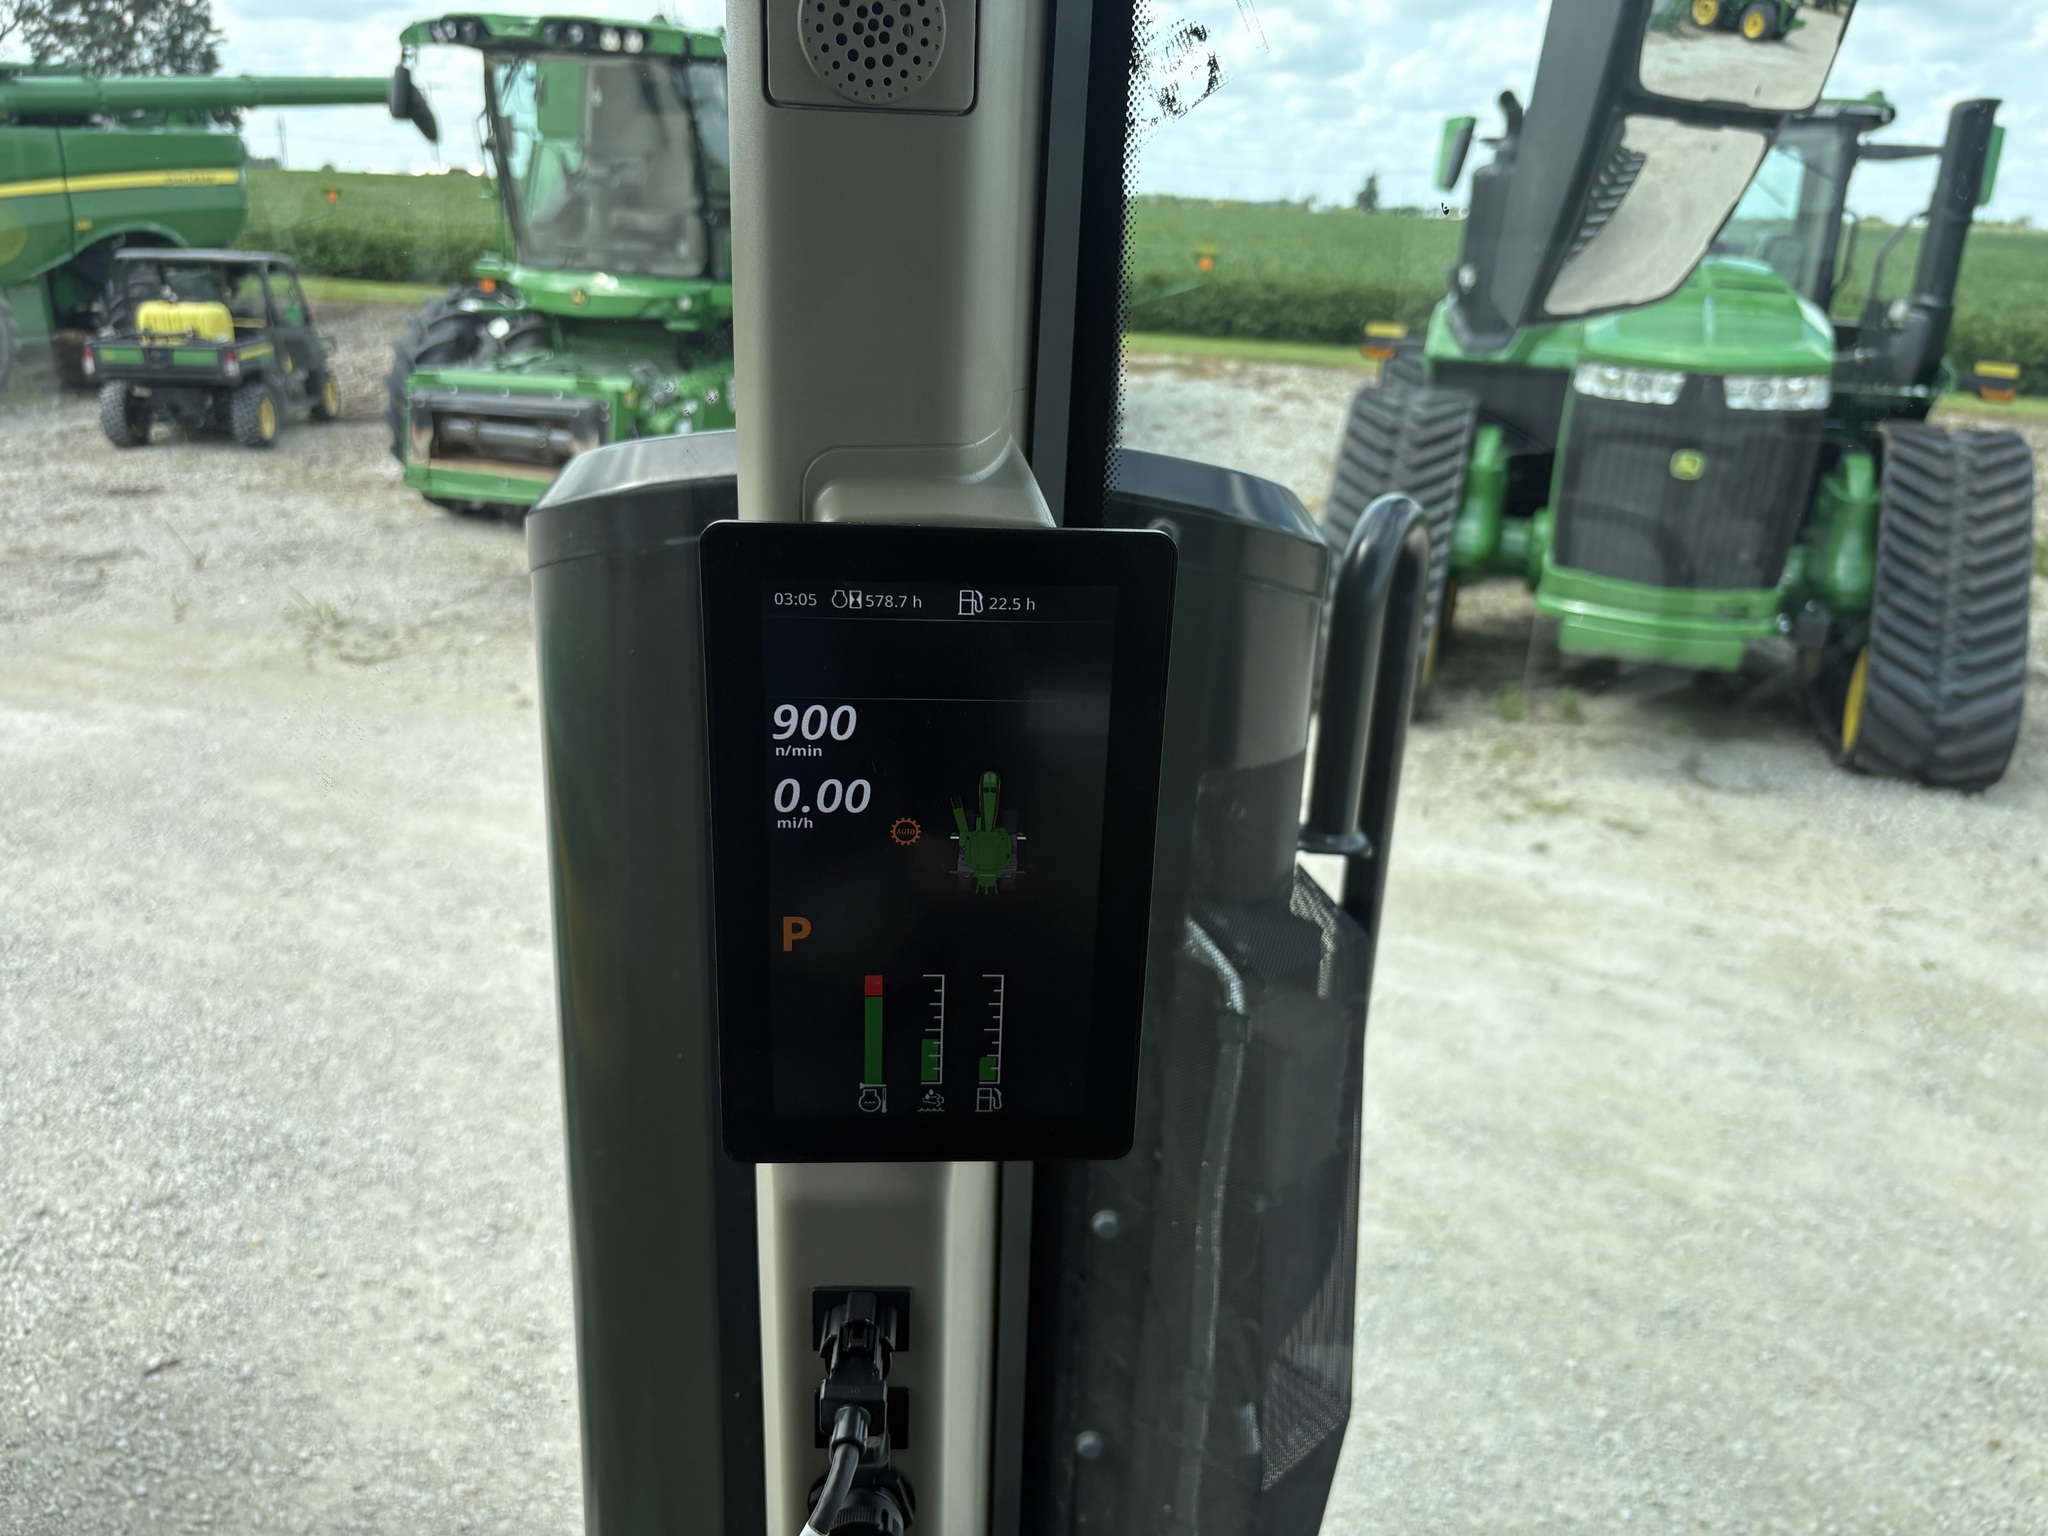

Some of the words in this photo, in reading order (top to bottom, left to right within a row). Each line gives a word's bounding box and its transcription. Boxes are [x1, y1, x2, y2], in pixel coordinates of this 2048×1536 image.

[774, 592, 817, 606] 03:05
[865, 595, 908, 608] 578.7
[913, 595, 923, 608] h
[988, 597, 1021, 611] 22.5
[1026, 596, 1036, 610] h
[772, 704, 857, 741] 900
[775, 745, 823, 757] n/min
[773, 778, 872, 814] 0.00
[777, 816, 814, 829] mi/h
[896, 828, 916, 836] AUTO
[782, 916, 812, 952] P
